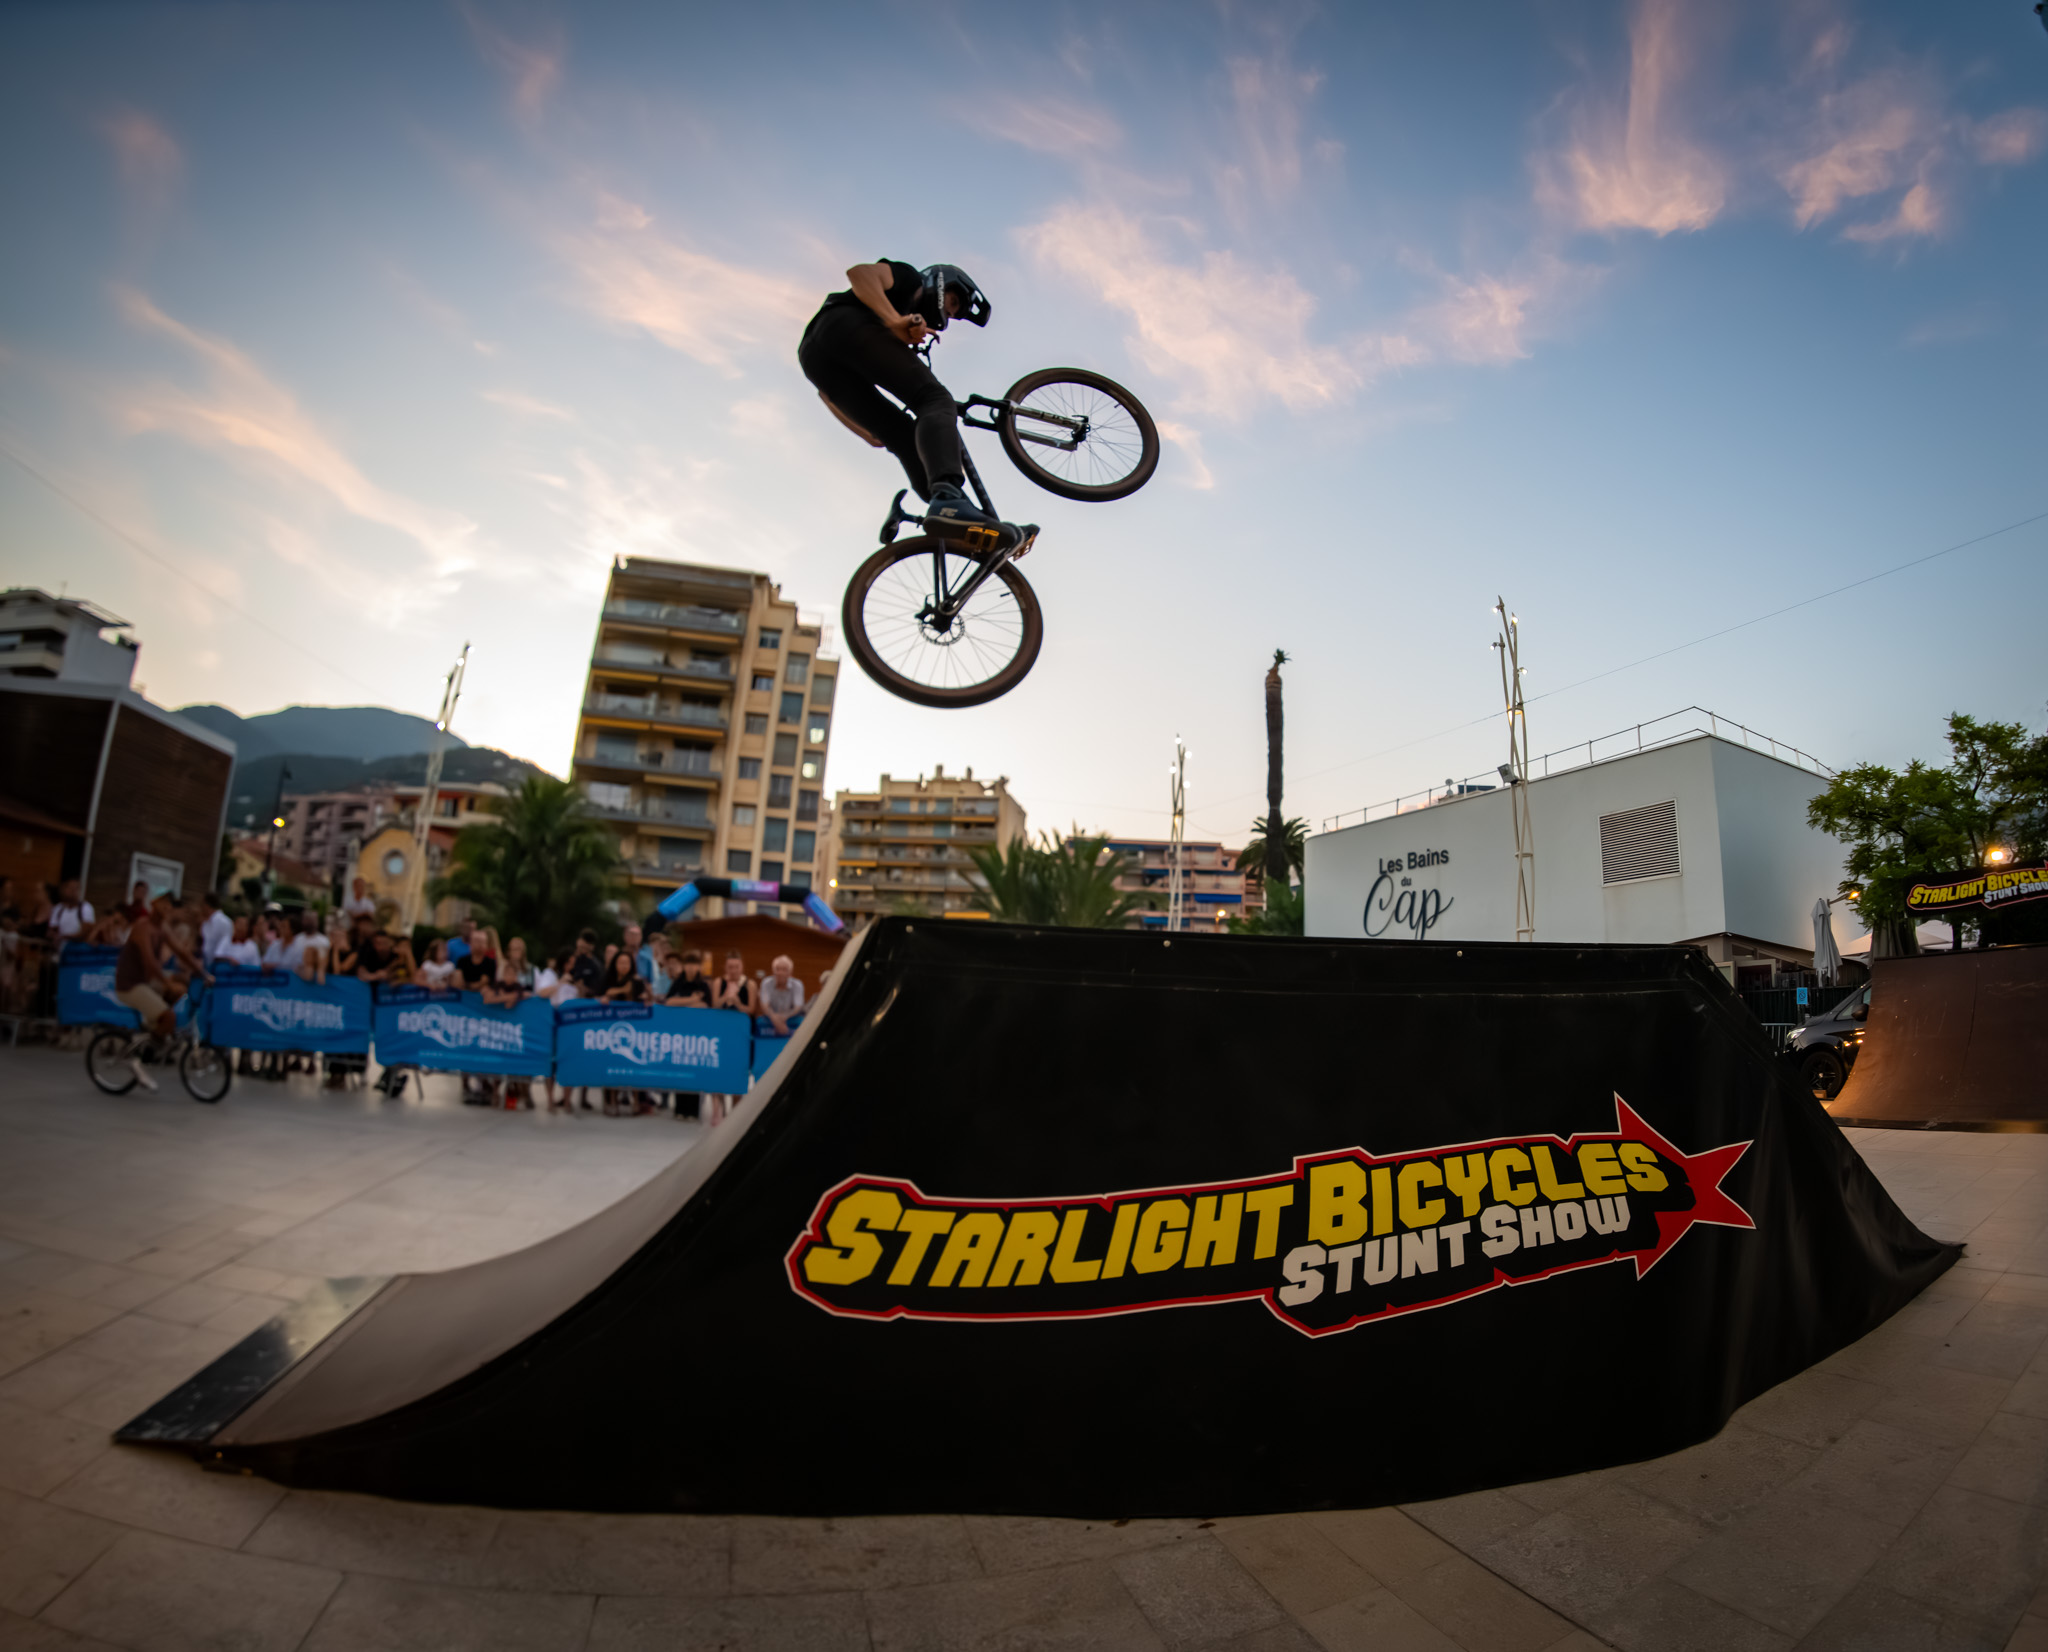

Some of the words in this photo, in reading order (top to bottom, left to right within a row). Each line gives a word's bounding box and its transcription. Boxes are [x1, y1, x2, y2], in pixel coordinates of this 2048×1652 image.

[1379, 858, 1403, 875] Les
[1407, 848, 1450, 870] Bains
[1401, 876, 1412, 887] du
[1909, 879, 1986, 905] STARLIGHT
[1984, 885, 2018, 903] STUNT
[1363, 874, 1454, 940] Cap
[583, 1021, 720, 1065] ROQUEBRUNE
[803, 1183, 1294, 1288] STARLIGHT
[1307, 1142, 1670, 1246] BICYCLES
[1278, 1220, 1471, 1307] STUNT
[1480, 1195, 1631, 1259] SHOW
